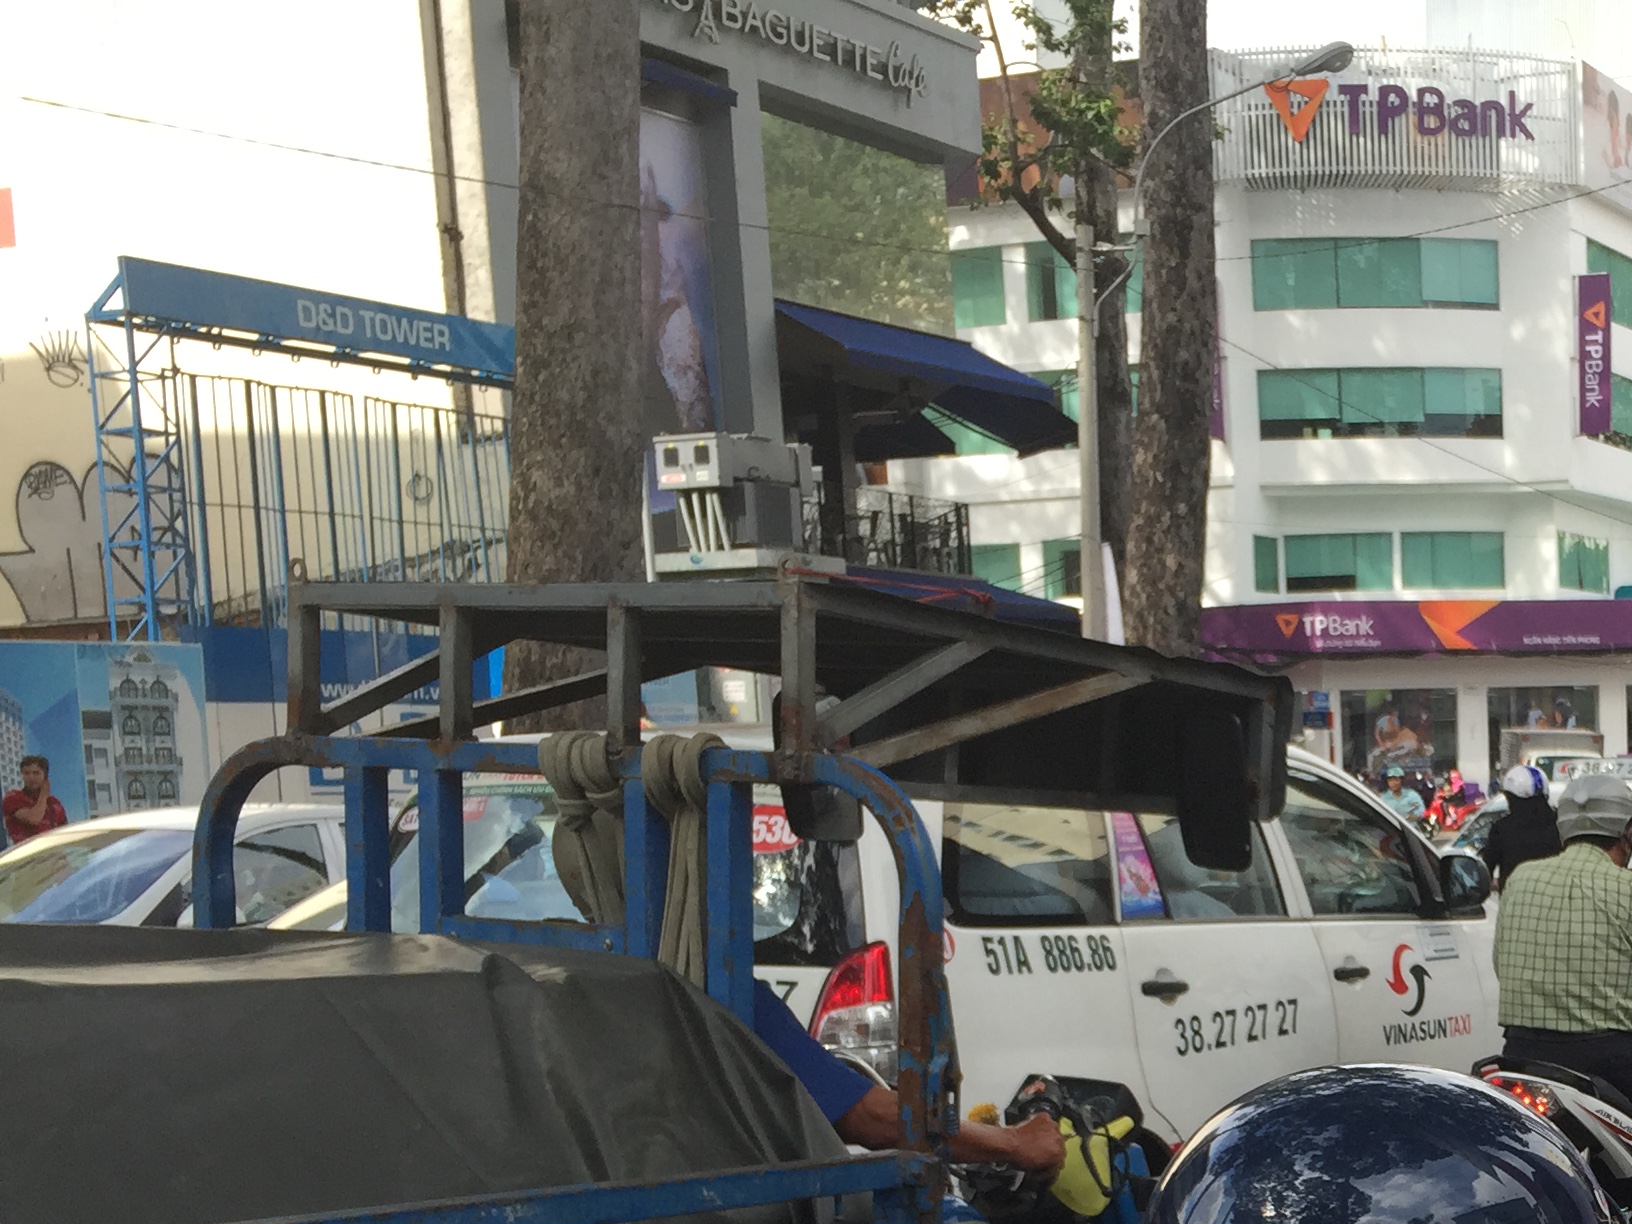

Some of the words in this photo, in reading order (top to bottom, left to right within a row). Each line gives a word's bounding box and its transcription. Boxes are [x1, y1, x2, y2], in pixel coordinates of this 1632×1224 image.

[721, 0, 884, 81] BAGUETTE
[1338, 83, 1535, 142] TPBank
[297, 299, 354, 335] D&D
[358, 309, 450, 352] TOWER
[1584, 330, 1604, 408] TPBank
[1302, 614, 1375, 637] TPBank
[981, 934, 1032, 976] 51A
[1041, 933, 1117, 974] 886.86
[1244, 1003, 1268, 1043] 27
[1276, 998, 1298, 1036] 27
